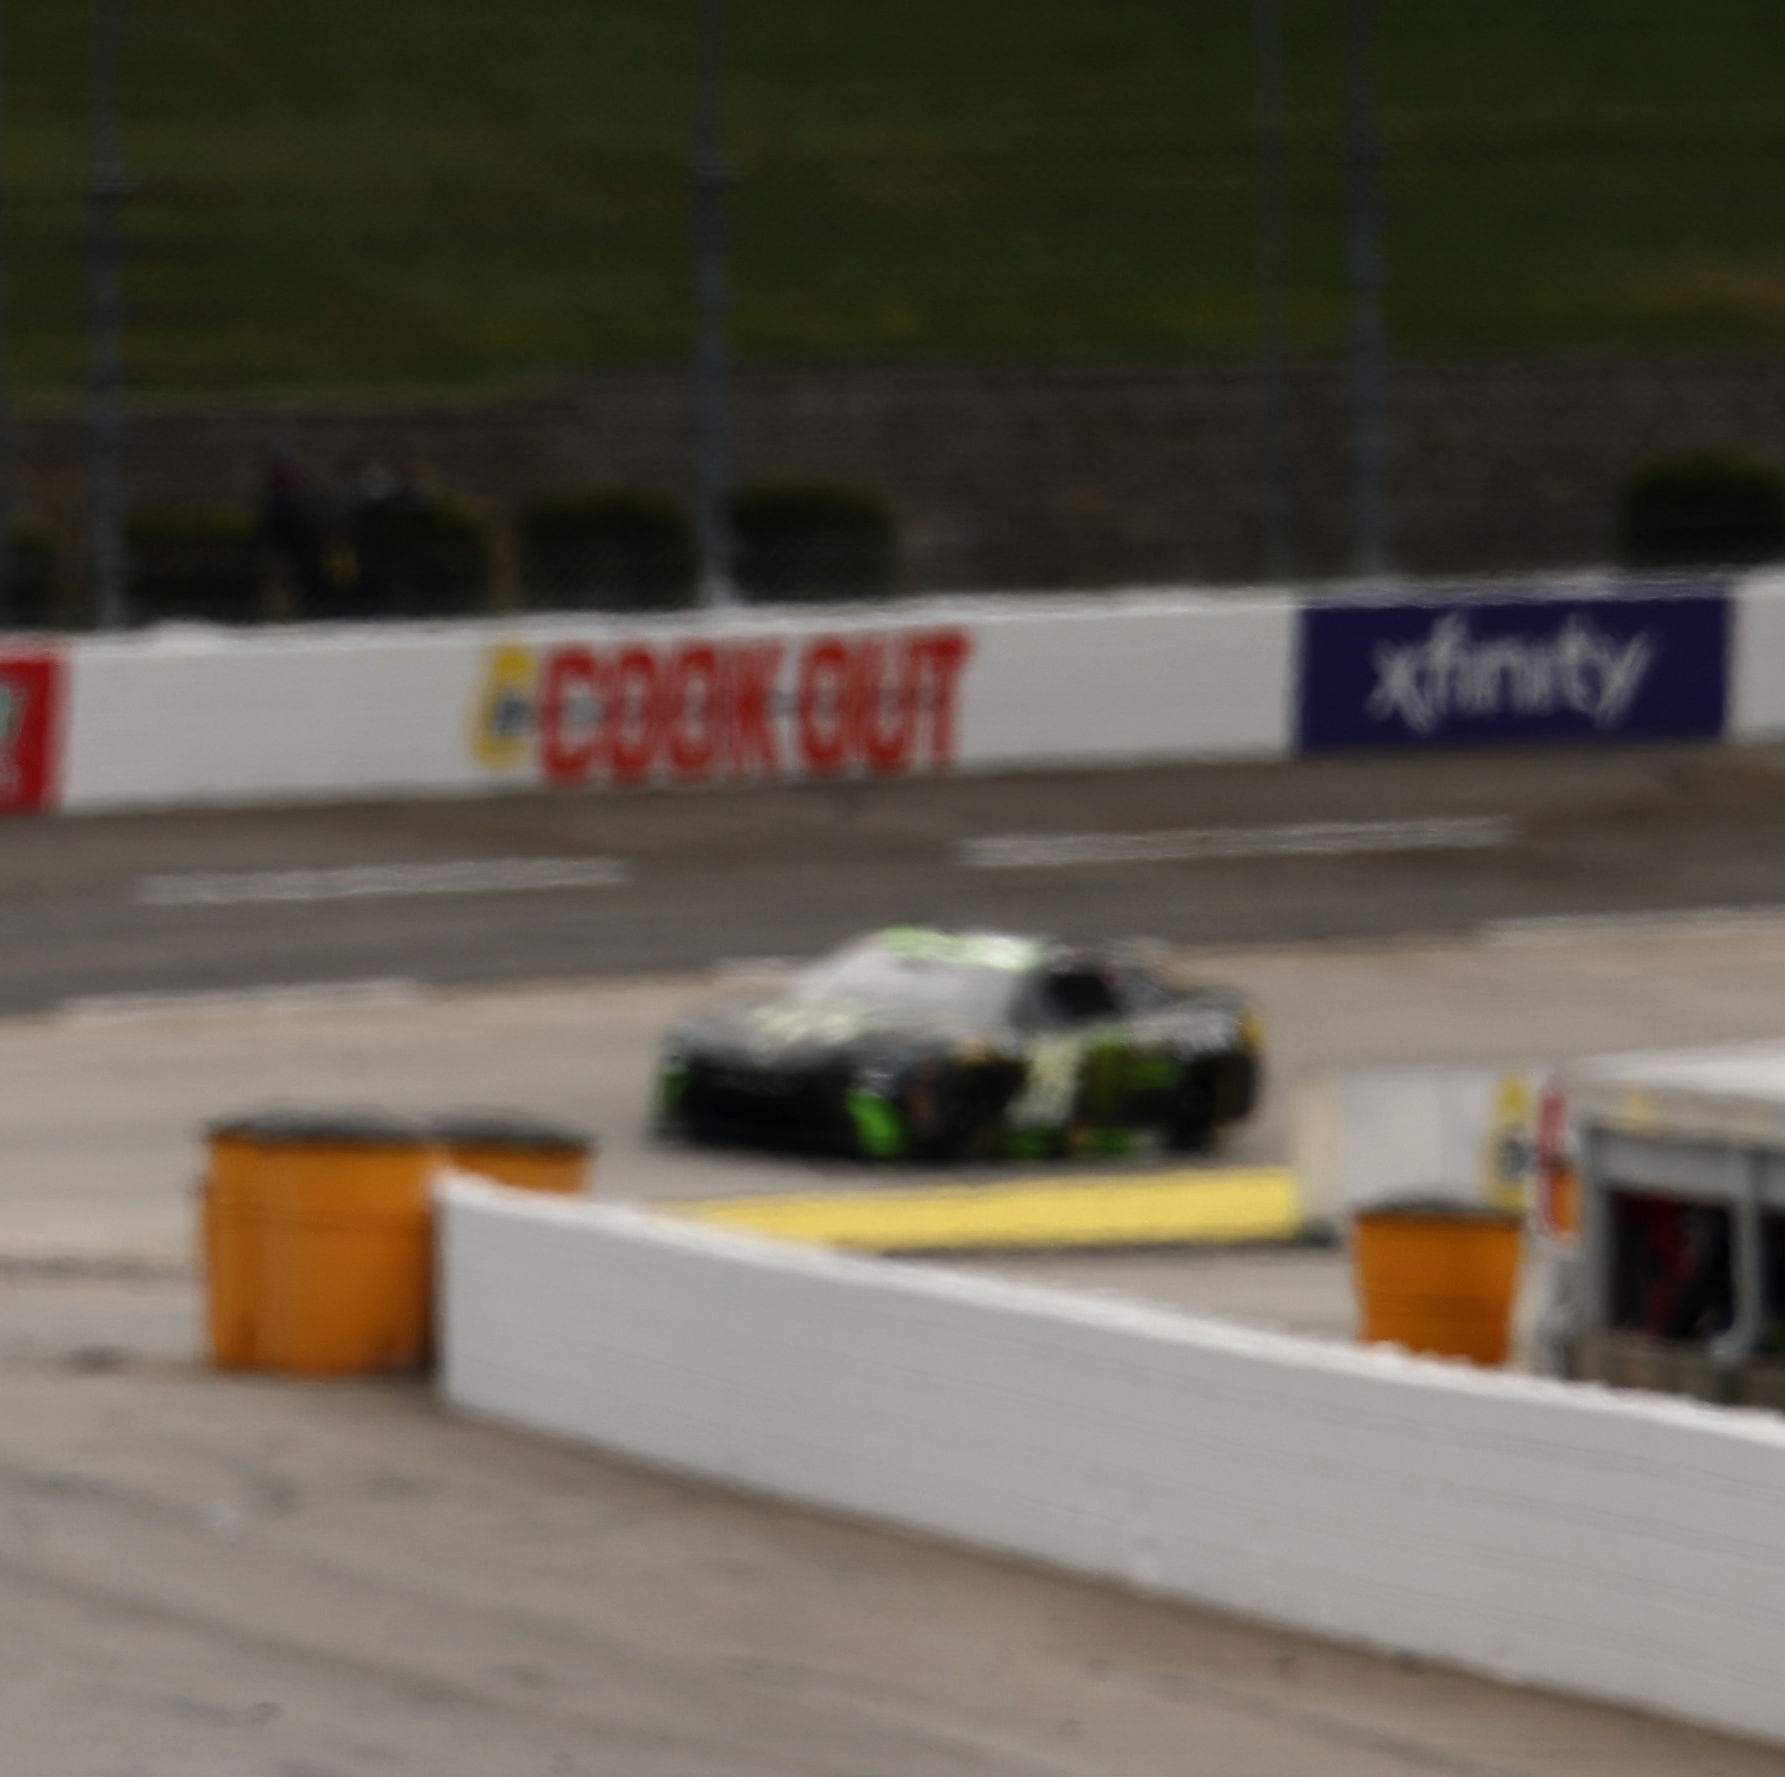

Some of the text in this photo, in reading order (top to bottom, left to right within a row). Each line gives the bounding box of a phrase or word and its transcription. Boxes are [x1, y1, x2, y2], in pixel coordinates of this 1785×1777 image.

[538, 628, 970, 786] COOK OUT
[1365, 612, 1656, 735] xfinity
